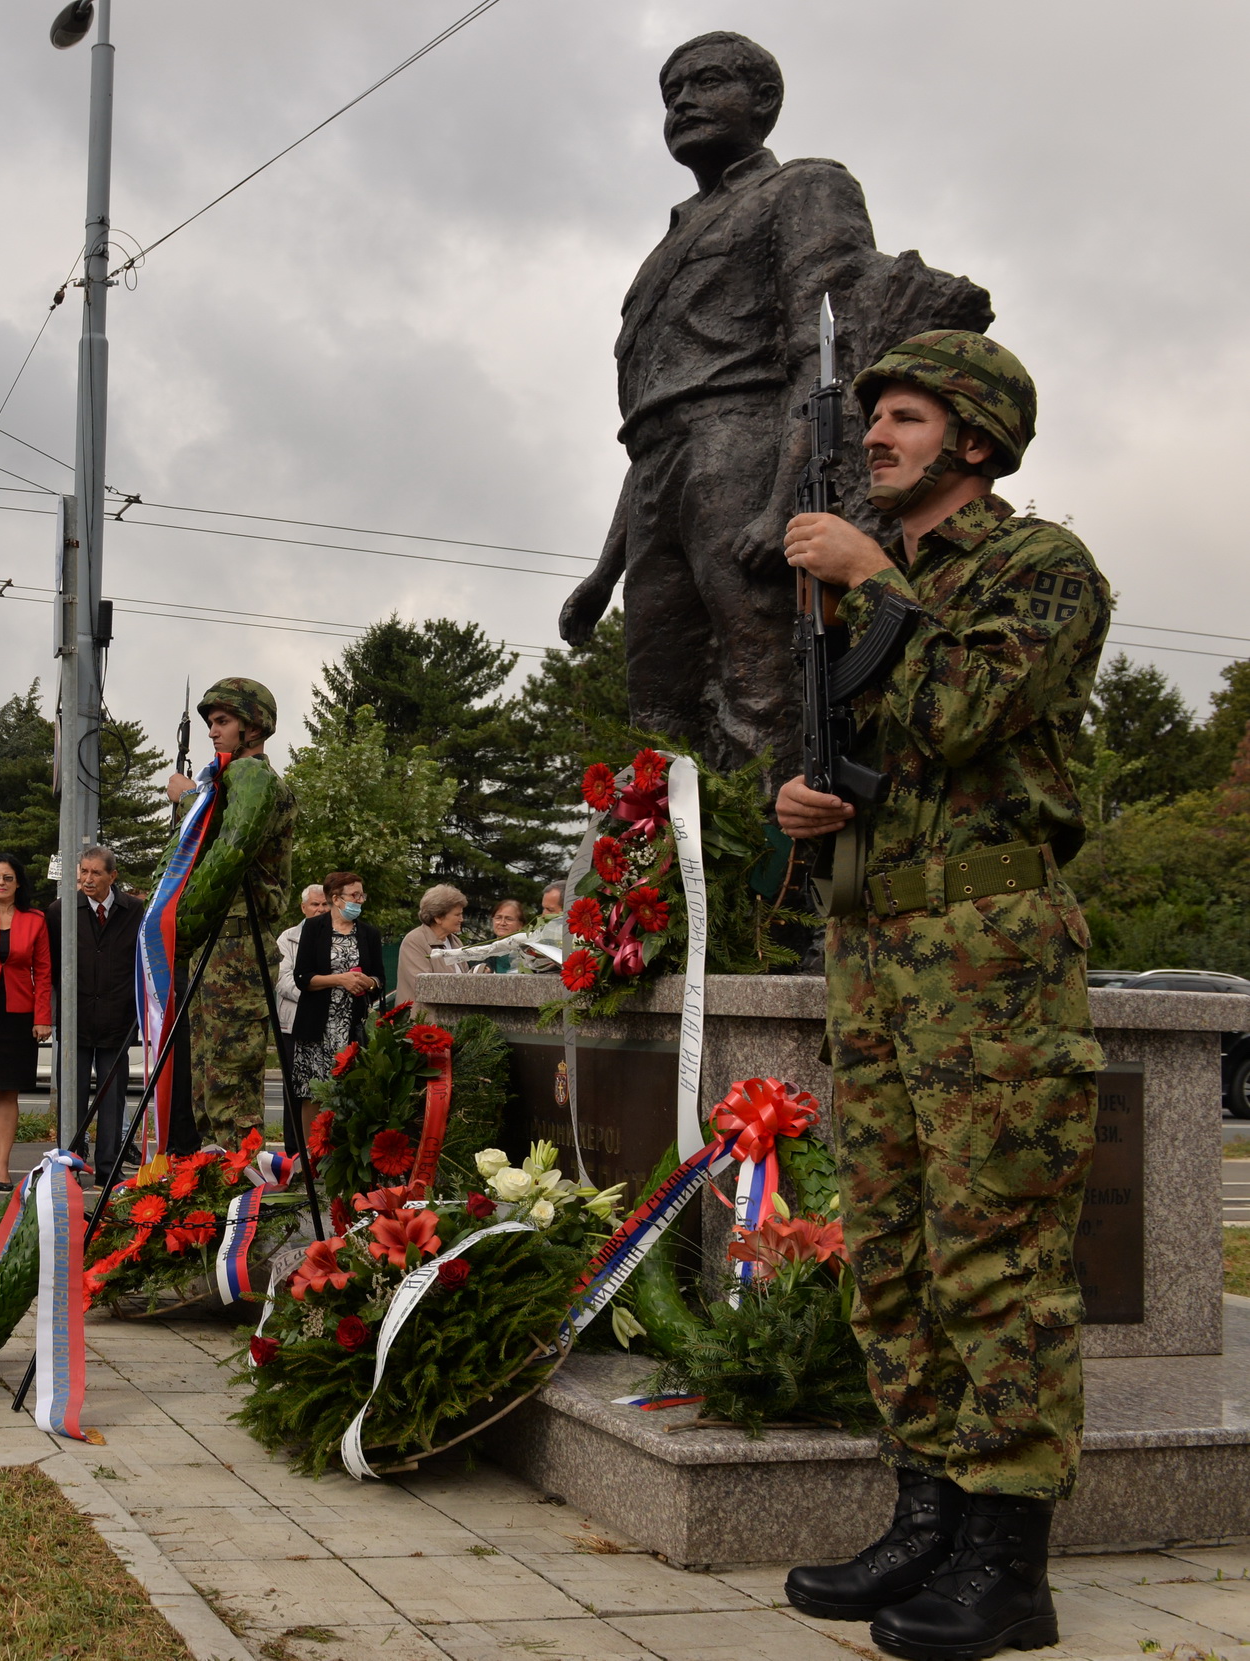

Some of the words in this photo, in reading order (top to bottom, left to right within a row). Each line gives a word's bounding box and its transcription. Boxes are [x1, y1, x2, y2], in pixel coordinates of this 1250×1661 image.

[51, 1171, 69, 1270] МИНИСТАРСТВО
[52, 1271, 69, 1331] ОДБРАНЕ
[53, 1344, 69, 1394] ВОЈСКА
